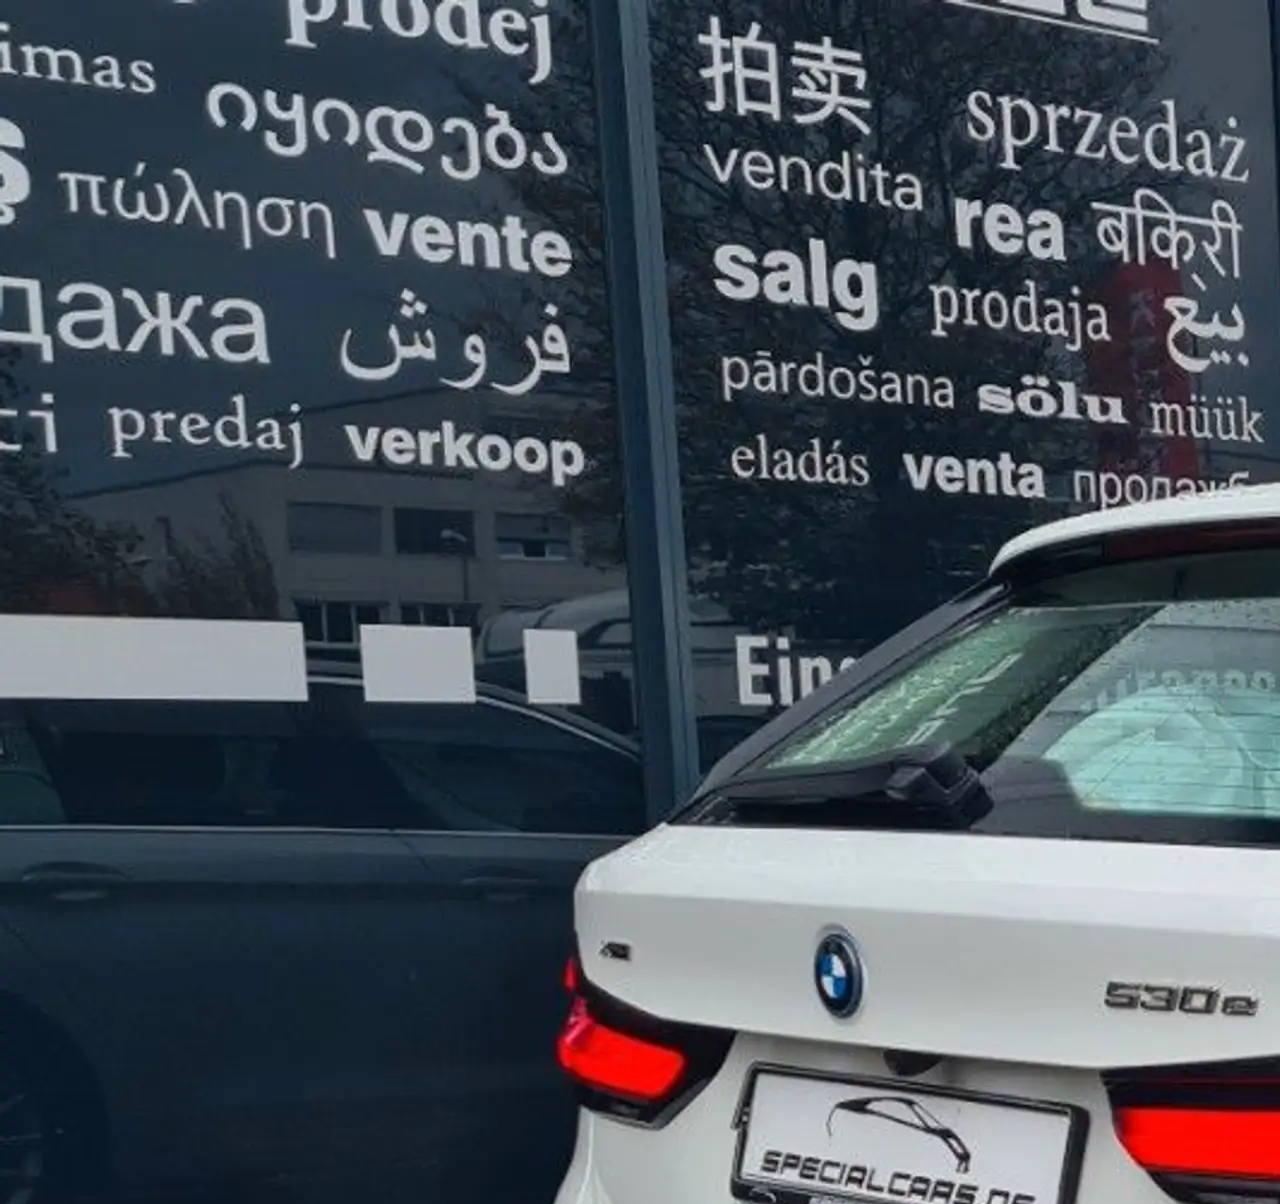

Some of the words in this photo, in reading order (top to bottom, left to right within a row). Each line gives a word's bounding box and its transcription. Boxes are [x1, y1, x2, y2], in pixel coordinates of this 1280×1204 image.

[285, 0, 551, 84] prodej
[698, 16, 871, 136] 拍卖
[207, 81, 568, 181] იყიდება
[967, 90, 1249, 183] sprzedaż
[58, 162, 336, 259] πώληση
[703, 144, 923, 211] vendita
[363, 209, 573, 277] vente
[954, 198, 1067, 261] rea
[713, 238, 879, 331] salg
[930, 281, 1111, 351] prodaja
[340, 289, 570, 395] فروش
[1163, 293, 1249, 373] بيع
[722, 352, 954, 409] pārdošana
[977, 376, 1129, 424] sölu
[108, 394, 302, 468] predaj
[344, 421, 585, 486] verkoop
[1150, 396, 1264, 443] müük
[731, 436, 870, 486] eladás
[902, 452, 1046, 499] venta
[735, 635, 858, 706] Ein
[1104, 982, 1258, 1016] 530e
